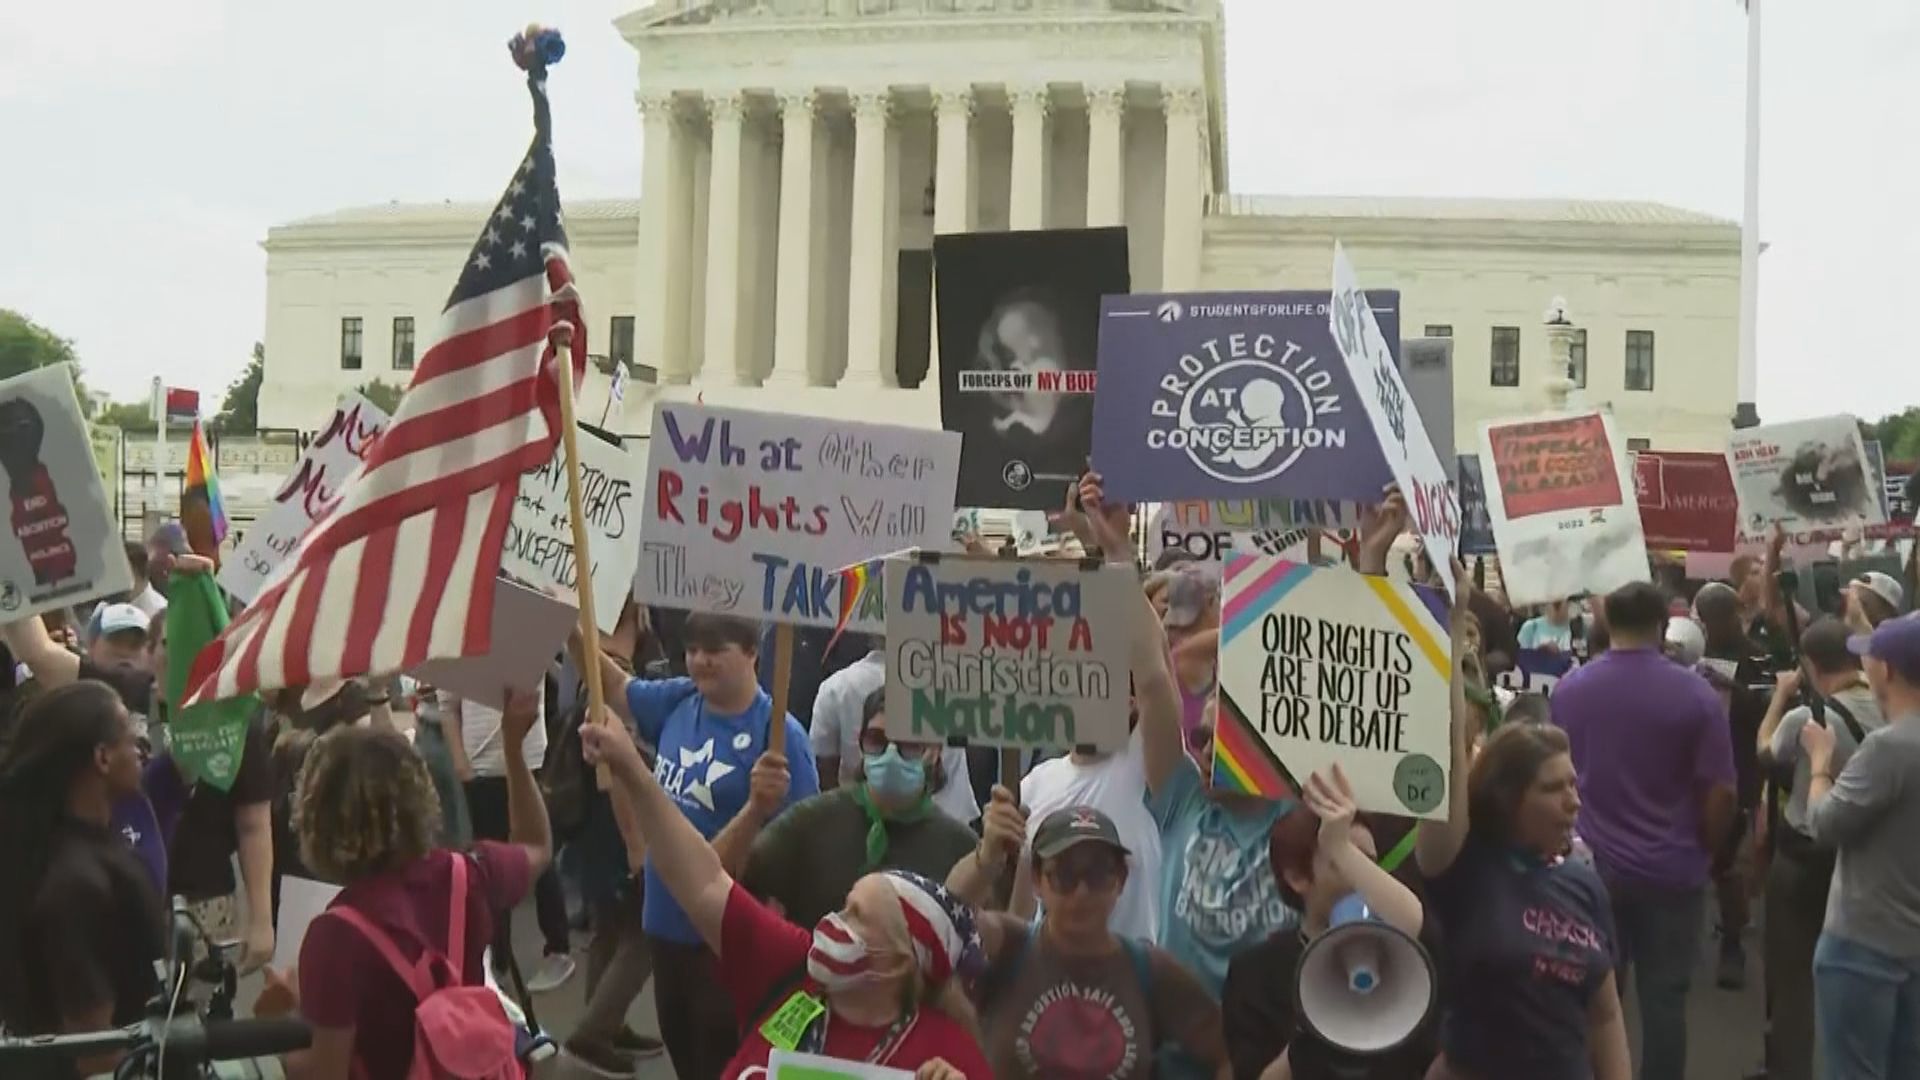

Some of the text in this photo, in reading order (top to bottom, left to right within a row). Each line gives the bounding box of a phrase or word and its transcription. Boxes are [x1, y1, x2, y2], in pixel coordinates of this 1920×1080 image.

[1190, 302, 1335, 317] STUDENTSFORLIFE.O
[962, 371, 1097, 391] FORCEPS OFF MY BO
[1152, 334, 1342, 417] PROTECTION
[1200, 388, 1237, 407] AT
[662, 410, 935, 480] What Other
[1147, 427, 1346, 449] CONCEPTION
[657, 470, 829, 542] Rights
[840, 494, 925, 538] Will
[503, 520, 598, 592] ONCEPTIO
[643, 541, 744, 611] They
[752, 552, 838, 618] TAK
[902, 566, 1080, 617] America
[940, 612, 1093, 651] IS NOT A
[1262, 613, 1412, 674] OUR RIGHTS
[897, 638, 1109, 699] Christian
[1260, 654, 1411, 711] ARE NOT UP
[911, 689, 1075, 743] Nation
[1261, 692, 1408, 752] FOR DEBATE
